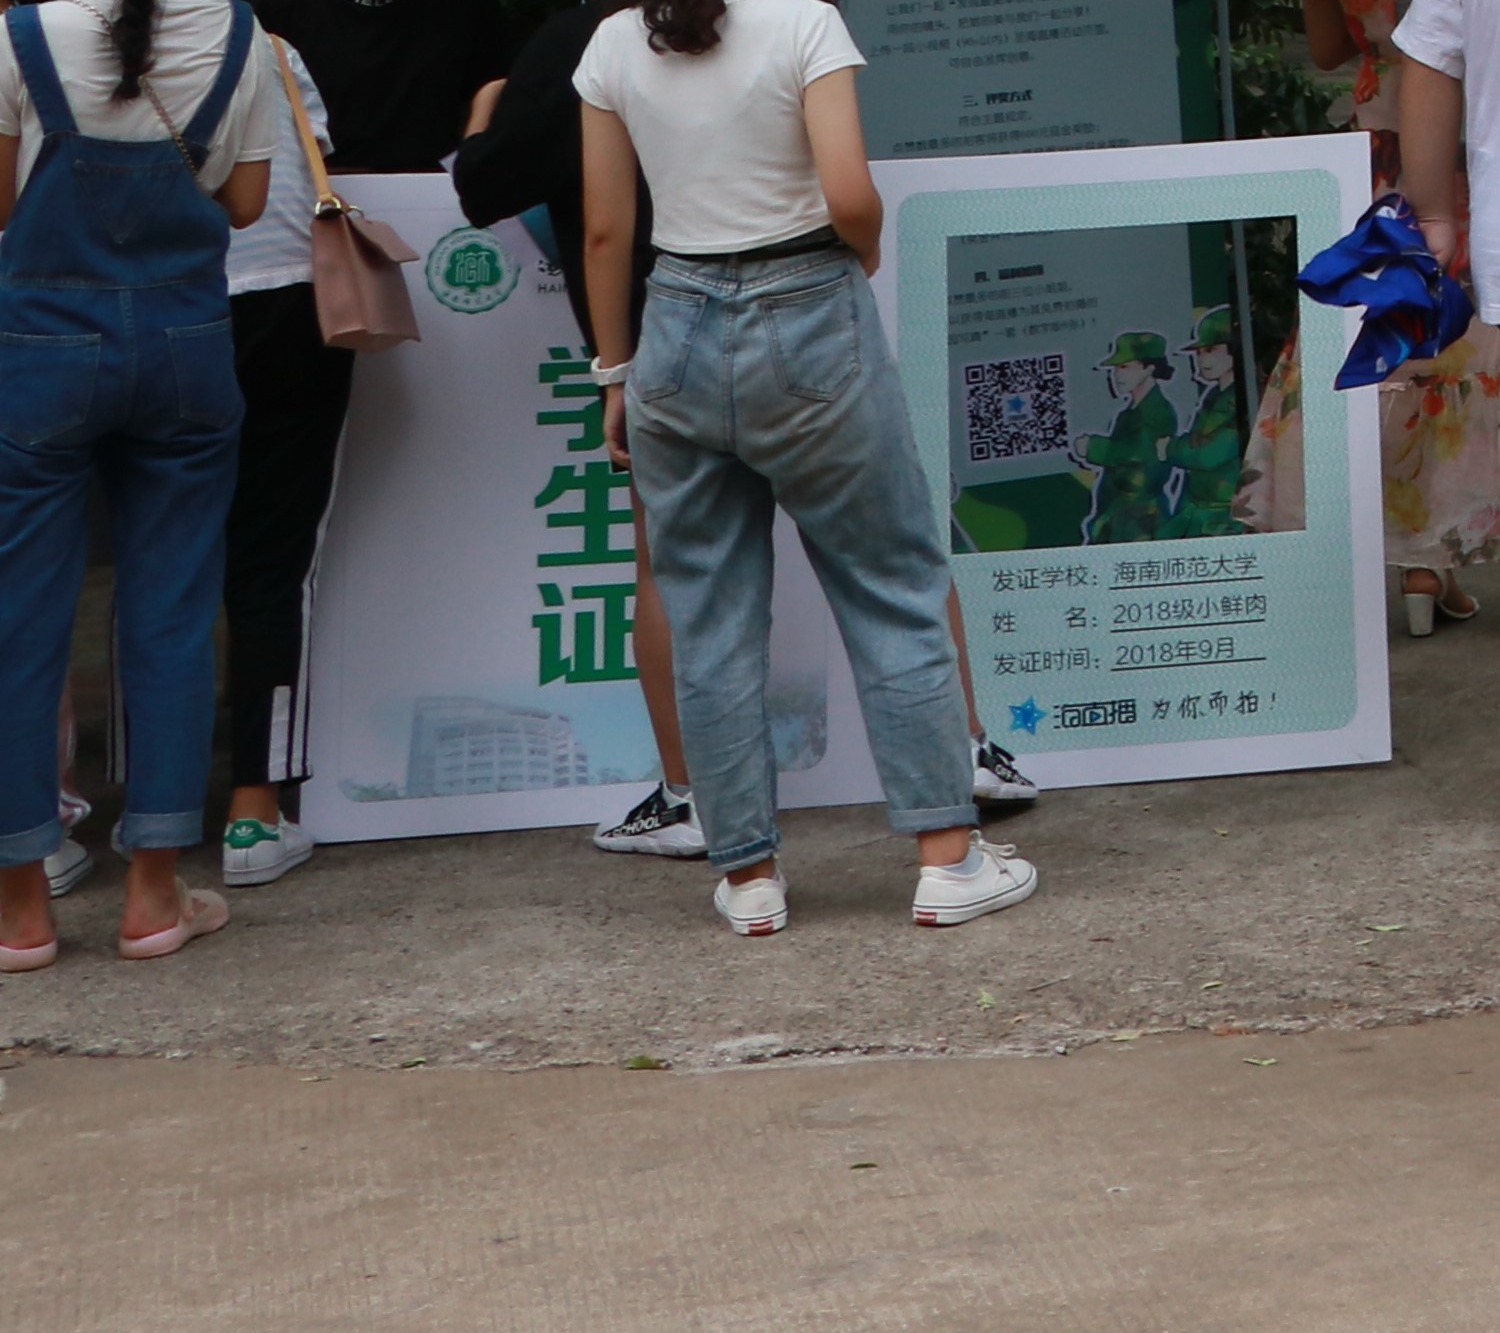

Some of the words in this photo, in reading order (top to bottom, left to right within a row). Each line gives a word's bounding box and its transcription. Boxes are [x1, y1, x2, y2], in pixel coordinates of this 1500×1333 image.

[1113, 553, 1259, 585] 海南师范大学
[1112, 592, 1268, 625] 2018级小鲜肉
[1114, 636, 1236, 666] 2018年9月
